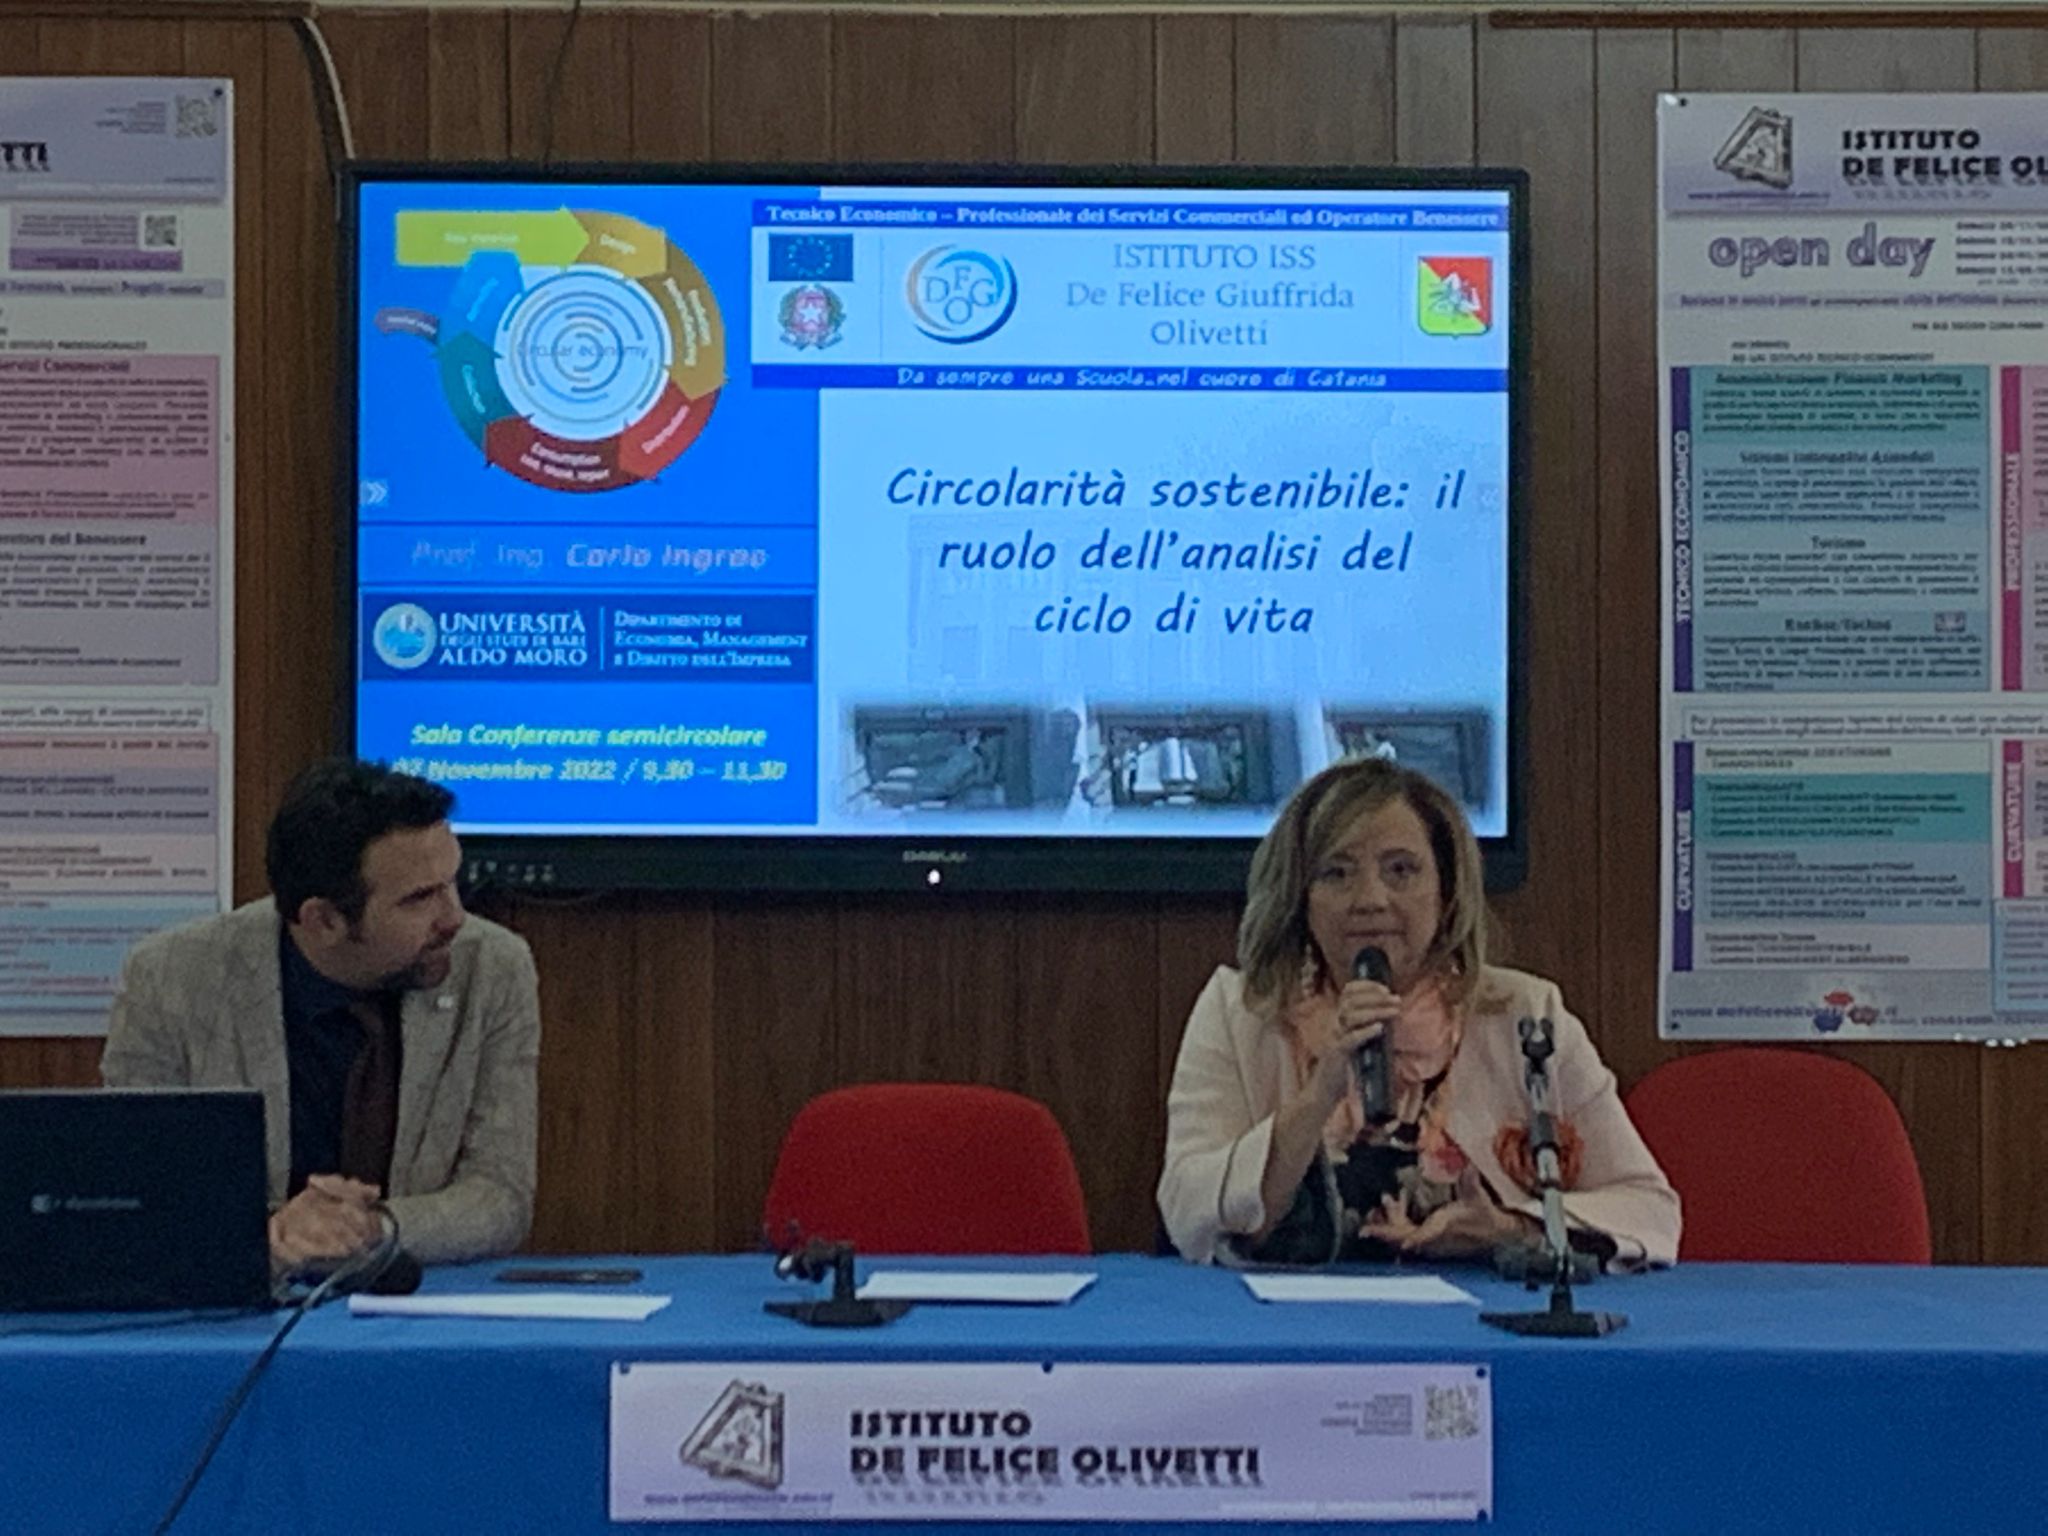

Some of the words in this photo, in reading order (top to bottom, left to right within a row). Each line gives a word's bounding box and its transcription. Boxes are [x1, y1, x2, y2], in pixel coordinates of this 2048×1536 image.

[1841, 130, 1980, 150] ISTITUTO
[1841, 156, 1884, 178] DE
[1893, 156, 2000, 178] FELICE
[765, 206, 835, 222] Tecnico
[839, 206, 938, 222] Economico
[956, 207, 1074, 224] Professionale
[1077, 207, 1105, 223] dei
[1108, 208, 1169, 224] Servizi
[1173, 208, 1288, 225] Commerciali
[1290, 209, 1312, 225] ed
[1316, 209, 1407, 227] Operatore
[1412, 210, 1498, 226] Benessere
[1113, 243, 1258, 270] ISTITUTO
[1269, 244, 1317, 270] ISS
[1707, 235, 1830, 277] open
[1845, 221, 1936, 276] day
[1066, 281, 1108, 307] De
[1117, 281, 1206, 307] Felice
[1214, 281, 1355, 309] Giuffrida
[1150, 319, 1269, 346] Olivetti
[897, 367, 925, 385] Da
[935, 370, 1014, 388] sempre
[1026, 370, 1064, 385] una
[1199, 371, 1262, 387] cuore
[1273, 367, 1297, 386] di
[1307, 369, 1388, 387] Catania
[887, 467, 1126, 507] Circolarità
[1149, 469, 1410, 509] sostenibile:
[1435, 469, 1467, 509] il
[566, 543, 652, 569] Carlo
[938, 529, 1056, 570] ruolo
[1342, 529, 1413, 571] del
[439, 610, 586, 633] UNIVERSITÀ
[1034, 593, 1131, 633] ciclo
[1155, 593, 1201, 633] di
[1224, 595, 1314, 634] vita
[438, 648, 507, 666] ALDO
[513, 648, 588, 666] MORO
[410, 723, 463, 746] Sala
[468, 723, 601, 750] Conferenze
[606, 723, 768, 747] semicircolare
[427, 758, 554, 781] Novembre
[558, 759, 617, 781] 2022
[620, 757, 641, 785] /
[850, 1411, 1032, 1438] ISTITUTO
[850, 1446, 905, 1475] DE
[918, 1446, 1060, 1475] FELICE
[1071, 1446, 1261, 1476] OLIVETTI
